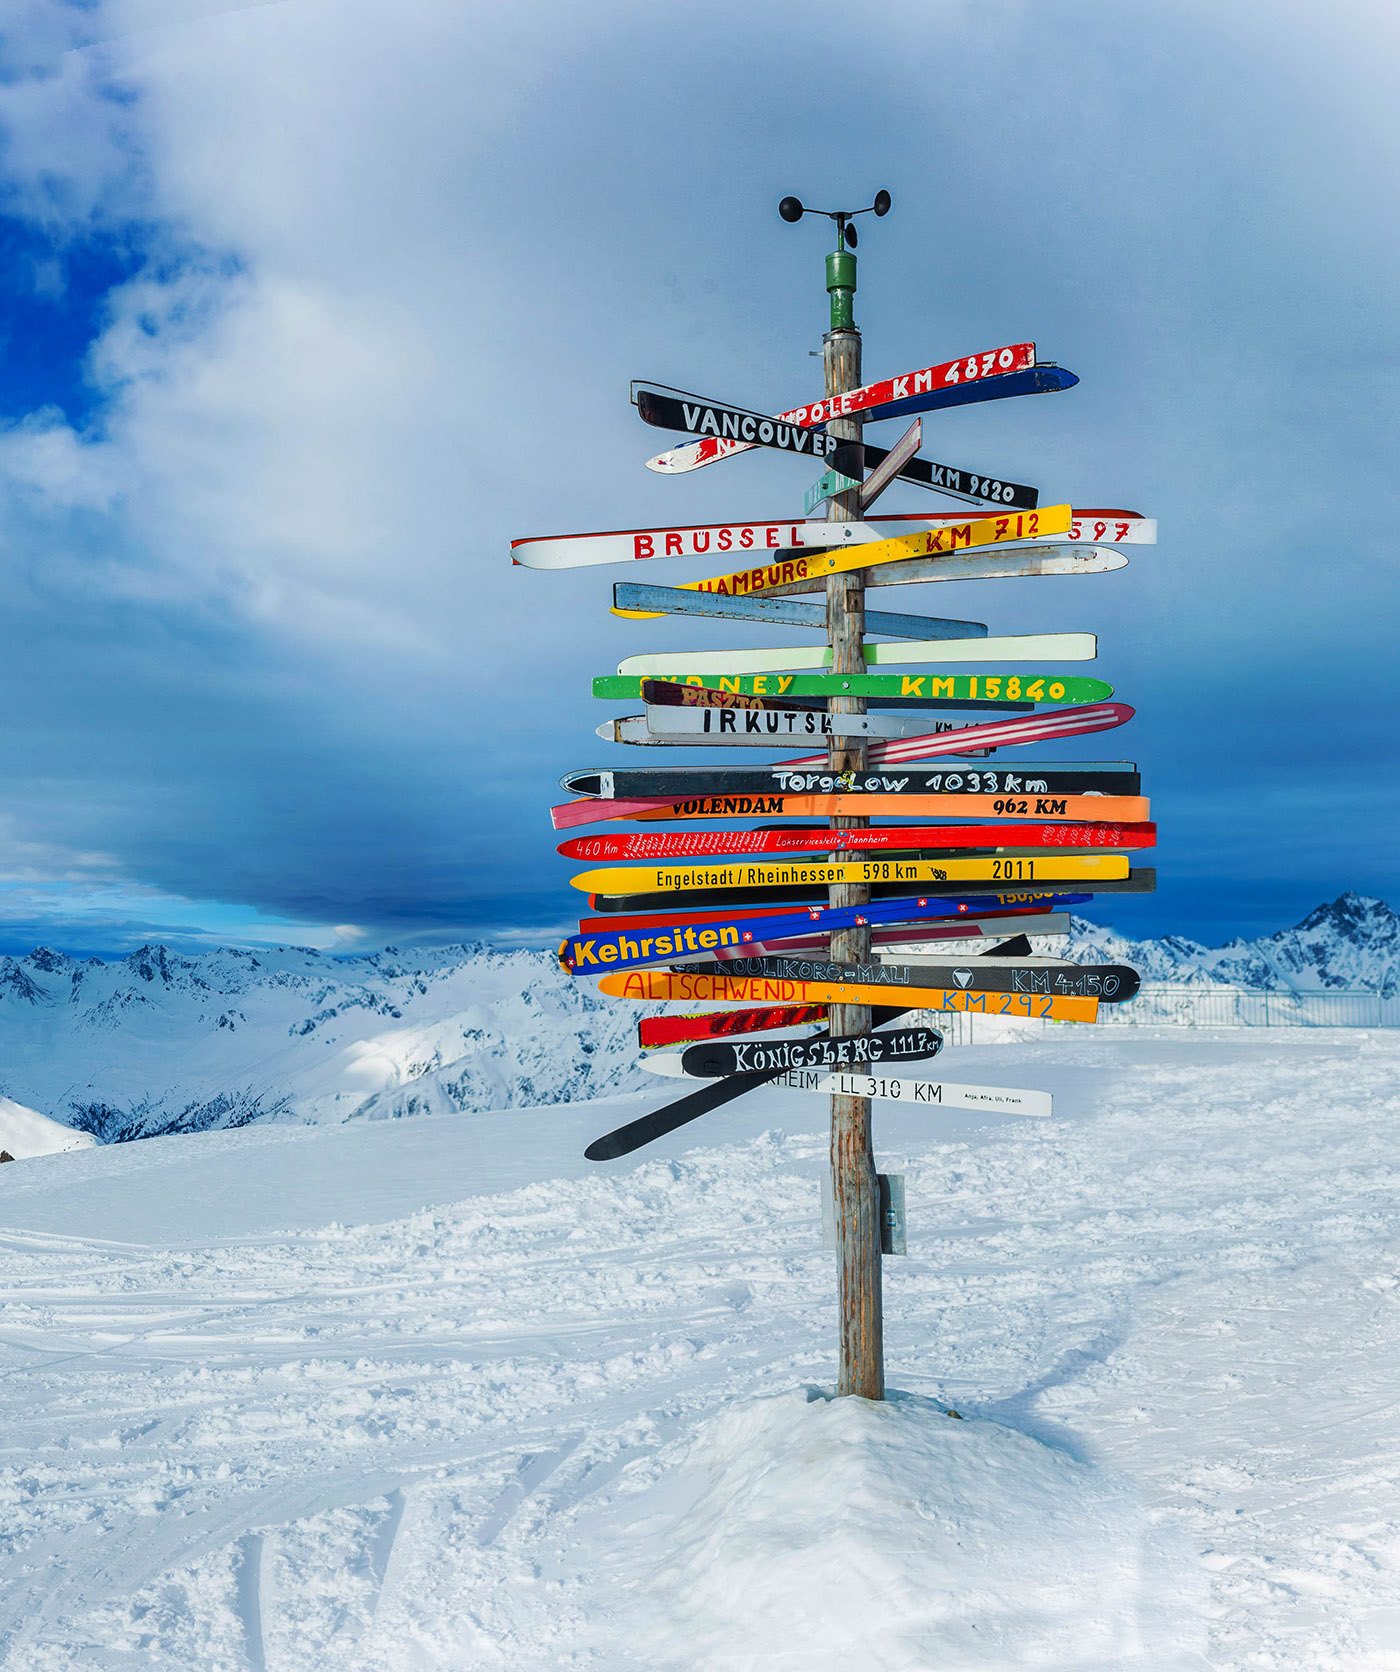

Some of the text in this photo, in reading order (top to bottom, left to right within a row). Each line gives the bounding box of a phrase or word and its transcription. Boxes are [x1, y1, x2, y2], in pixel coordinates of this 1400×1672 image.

[892, 370, 932, 398] KM
[944, 348, 1014, 384] 4870
[682, 403, 837, 455] VANCOUVER
[931, 464, 960, 490] KM
[969, 475, 1015, 502] 9620
[633, 526, 805, 560] BRÜSSEL
[926, 524, 972, 553] KM
[994, 512, 1040, 541] 712
[900, 676, 955, 698] KM
[969, 676, 1066, 702] 15840
[702, 708, 834, 734] IRKUTSK
[925, 771, 999, 793] 1033
[672, 797, 1068, 815] VOLENDAM 962 KM
[576, 840, 601, 857] 460
[656, 869, 734, 890] Engelstadt
[747, 866, 845, 884] Rheinhessen
[863, 863, 890, 880] 598
[895, 863, 918, 879] km
[992, 860, 1035, 880] 2011
[573, 925, 740, 967] Kehrsiten
[623, 972, 1054, 1019] ALTSCHWENDT KM 292
[1011, 969, 1051, 994] KM
[1054, 973, 1121, 997] 4.150
[840, 1075, 860, 1095] LL
[866, 1077, 901, 1099] 310
[914, 1082, 943, 1104] KM
